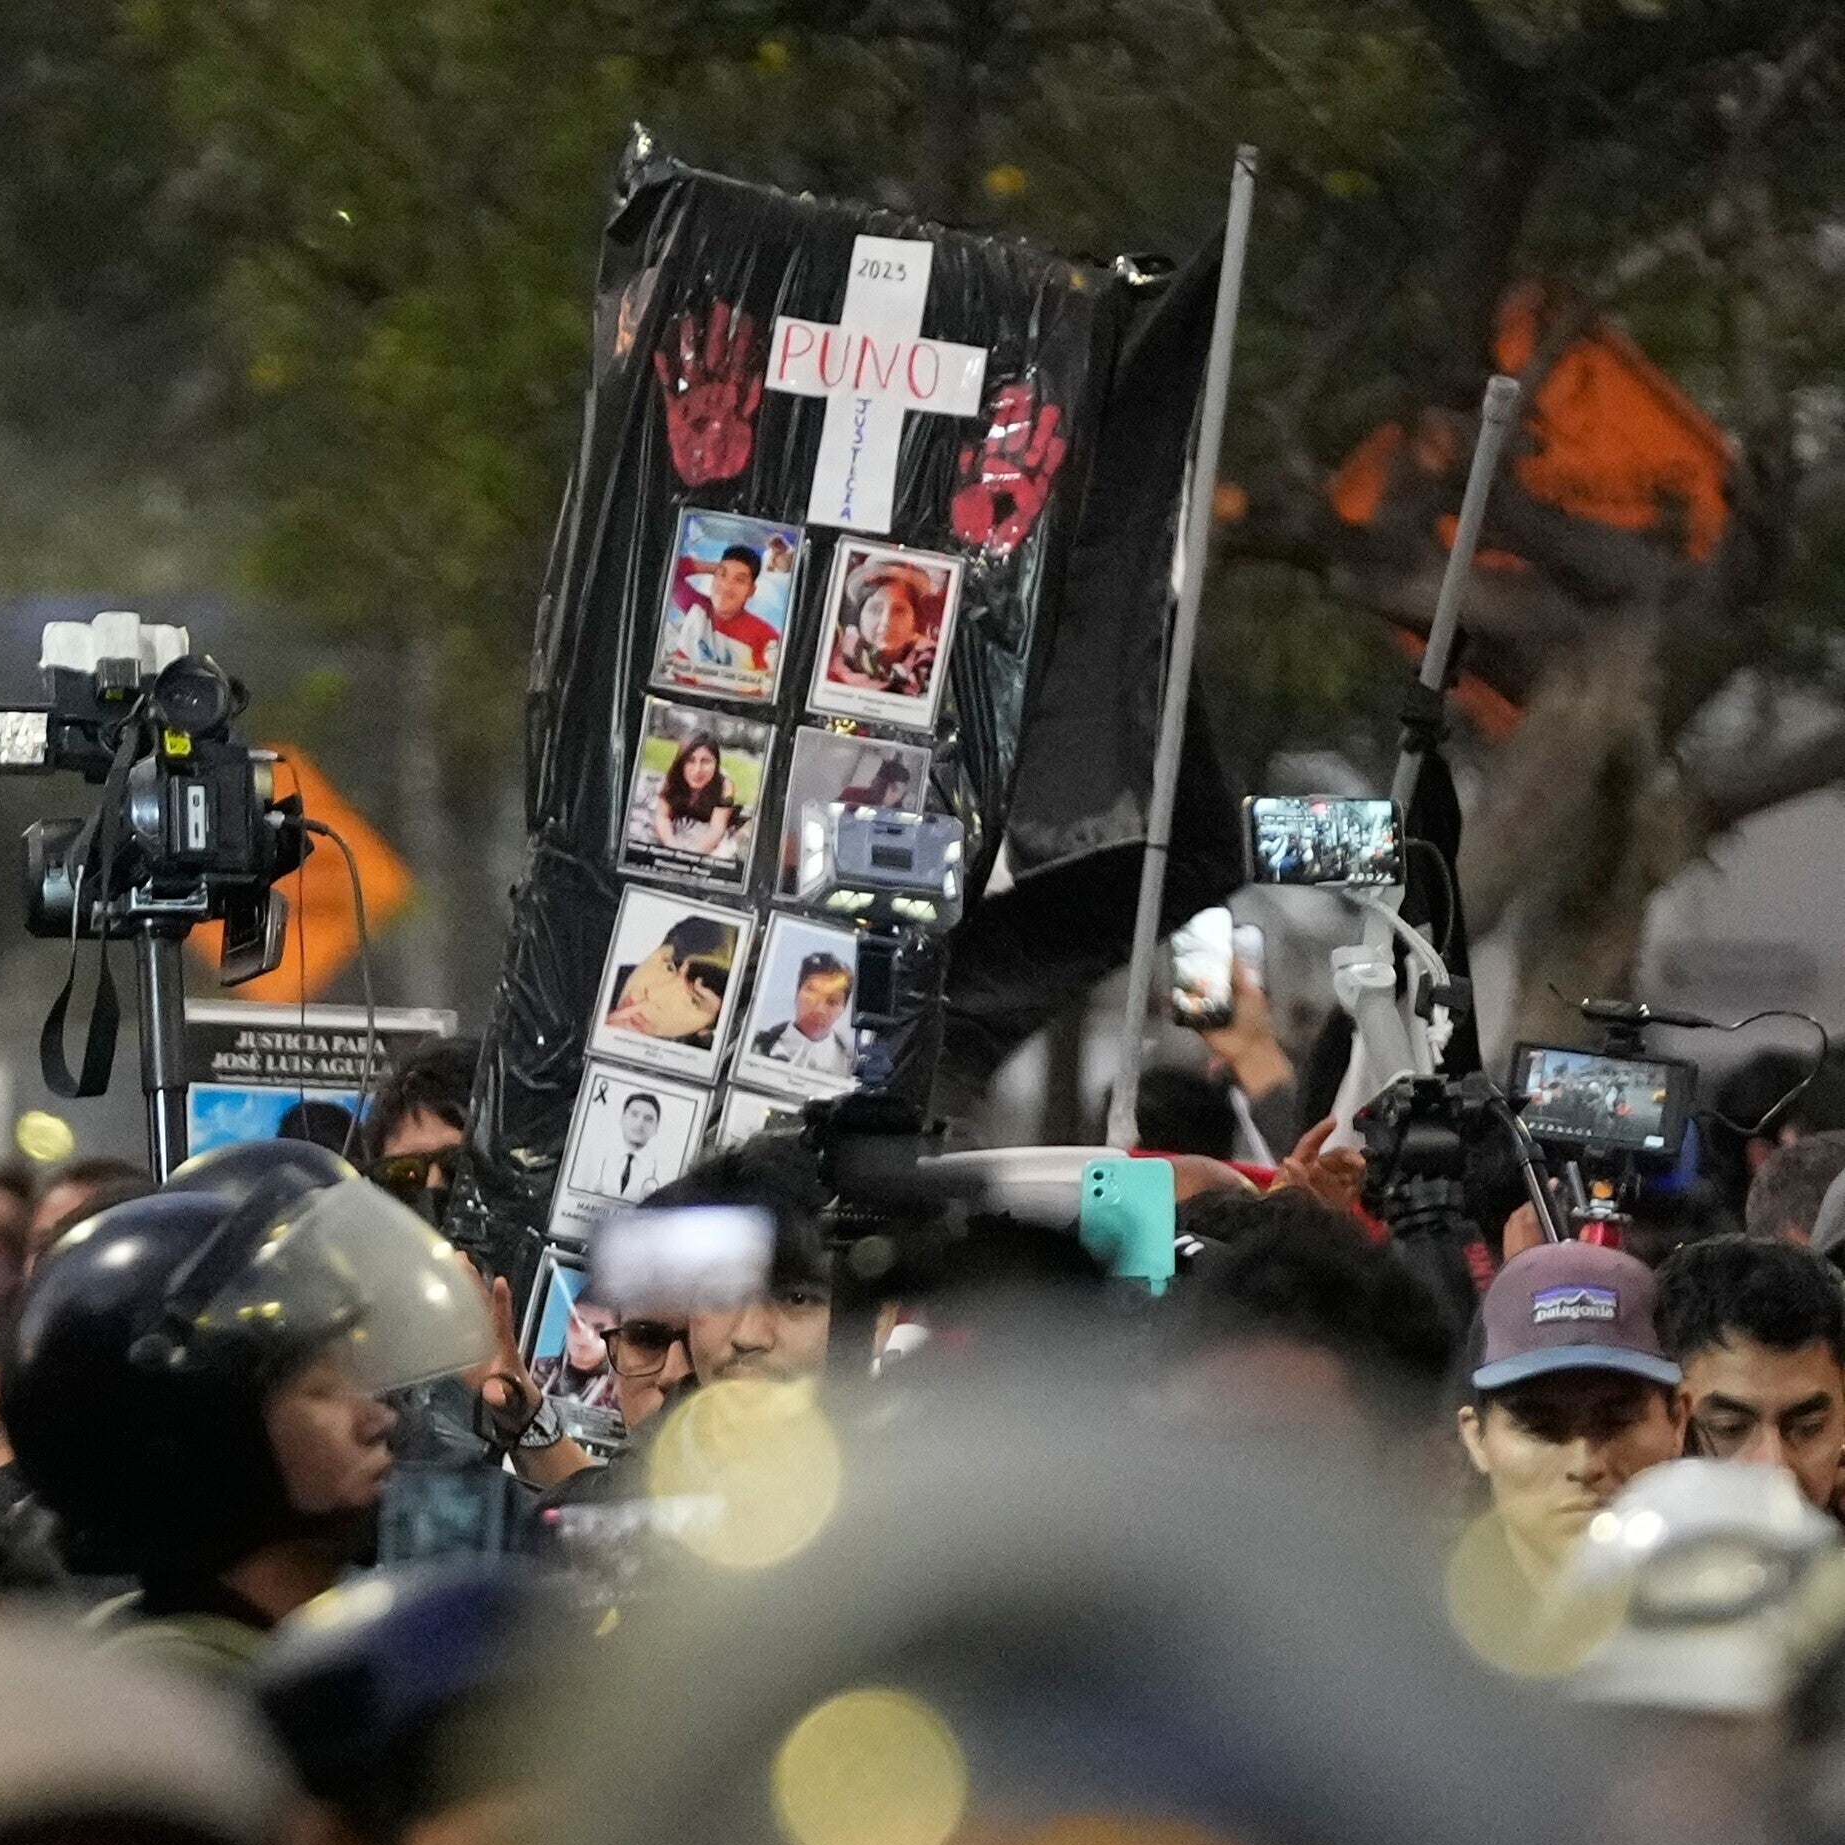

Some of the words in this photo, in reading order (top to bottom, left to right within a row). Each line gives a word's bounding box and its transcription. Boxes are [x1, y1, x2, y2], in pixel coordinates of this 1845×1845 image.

[857, 259, 907, 282] 2023
[779, 324, 940, 399] PUNO
[236, 1031, 329, 1052] JUSTICIA
[266, 1054, 313, 1073] LUIS
[1534, 1306, 1615, 1323] patagonia
